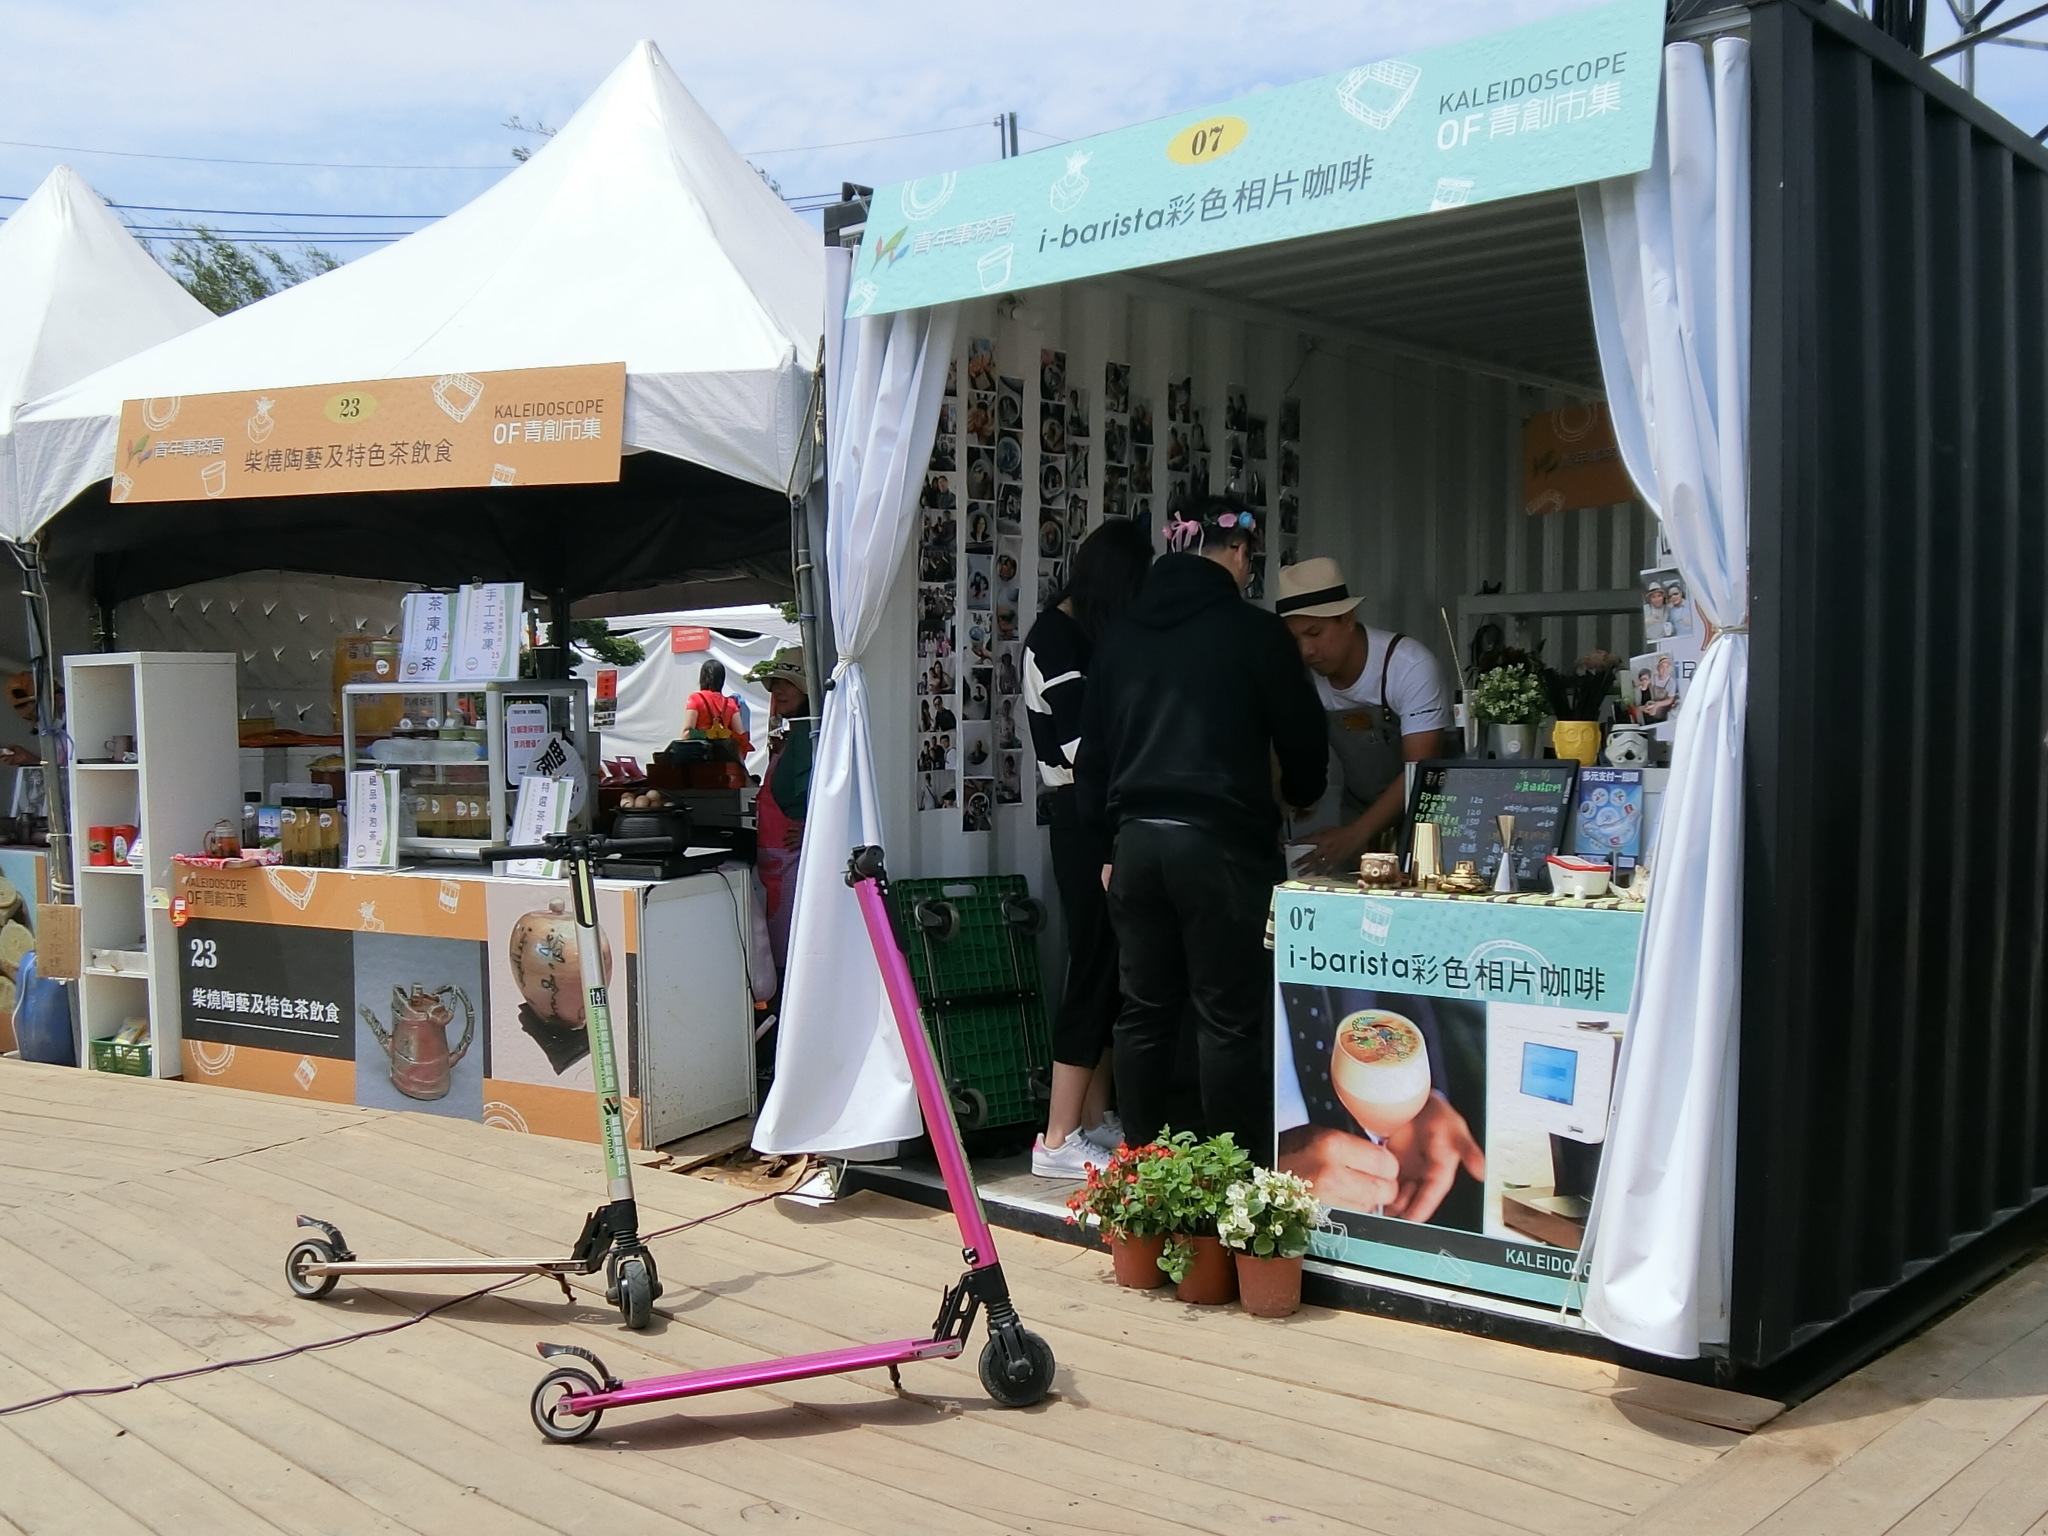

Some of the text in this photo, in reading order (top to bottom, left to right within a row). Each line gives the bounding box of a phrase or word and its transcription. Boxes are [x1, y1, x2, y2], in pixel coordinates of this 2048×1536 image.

[1439, 52, 1628, 115] KALEIDOSCOPE
[1437, 80, 1623, 151] OF 青創市集
[1191, 124, 1224, 157] 07
[340, 397, 361, 418] 23
[494, 399, 604, 419] KALEIDOSCOPE
[493, 417, 601, 444] OF 青創市集
[244, 437, 454, 474] 柴燒陶藝及特色茶飲食
[421, 595, 442, 672] 茶凍奶茶
[481, 588, 497, 650] 手工茶凍
[186, 890, 202, 905] OF
[1289, 906, 1316, 932] 07
[190, 938, 218, 969] 23
[192, 987, 340, 1024] 柴燒陶藝及特色茶飲食
[1506, 1248, 1592, 1278] KALEIDOC
